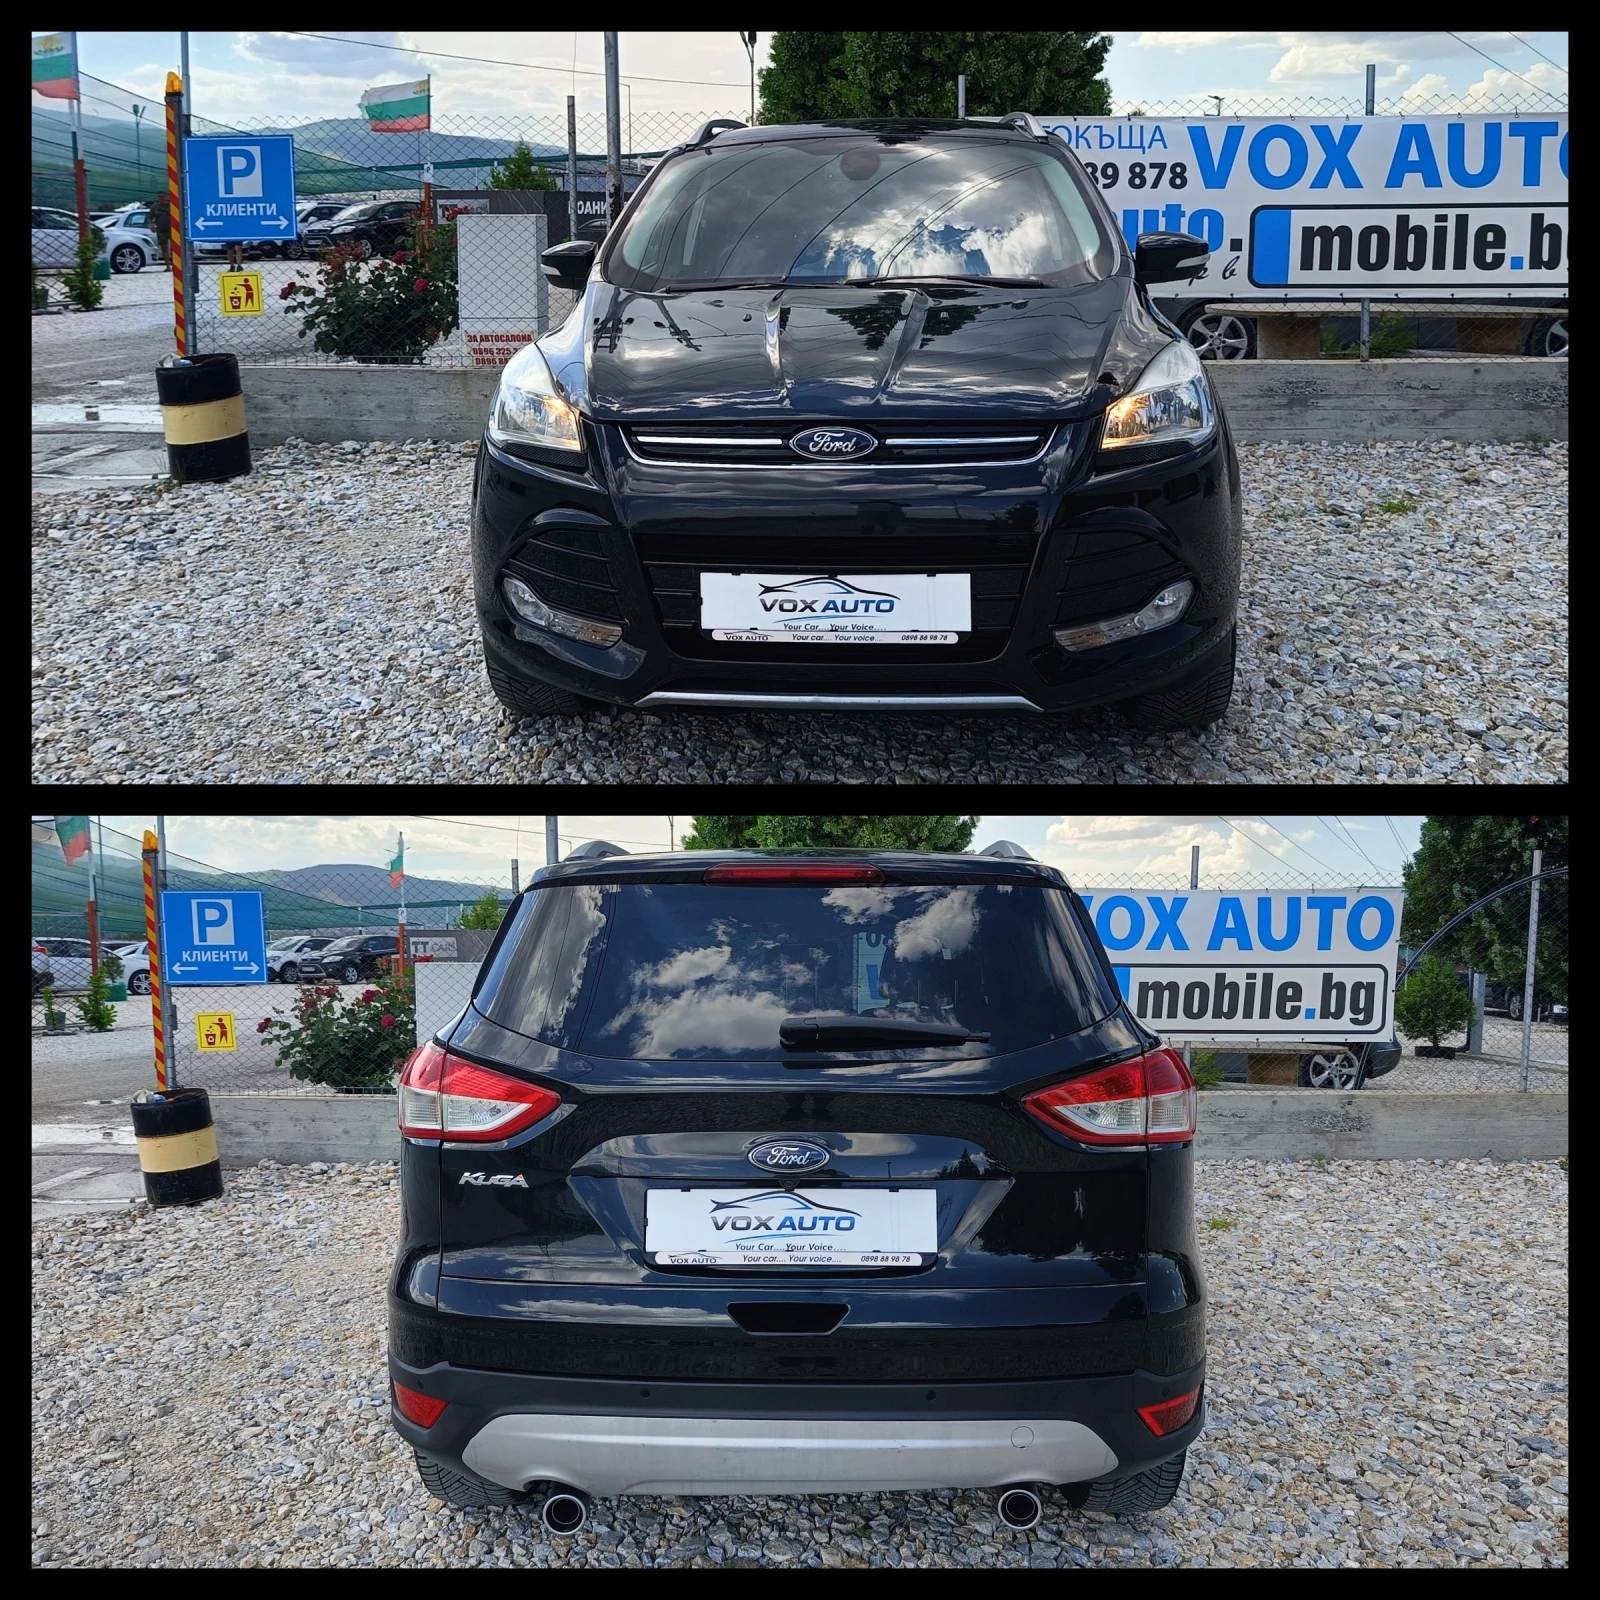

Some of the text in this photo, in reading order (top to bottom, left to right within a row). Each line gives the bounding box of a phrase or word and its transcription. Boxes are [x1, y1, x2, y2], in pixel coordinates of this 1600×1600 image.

[1042, 125, 1168, 154] ОКЪЩА
[1187, 121, 1568, 190] VOX AUT
[1128, 162, 1188, 189] 878
[206, 203, 277, 216] КЛИЕНТИ
[1300, 213, 1568, 271] mobile.b
[480, 334, 532, 342] АВТОСАЛОНА
[809, 431, 856, 452] Ford
[760, 599, 895, 613] VOX AUTO
[792, 633, 809, 641] Your
[1207, 895, 1395, 952] AUTO
[182, 950, 249, 962] КЛИЕНТИ
[1137, 972, 1376, 1026] mobile.bg
[766, 1146, 811, 1165] Ford
[459, 1172, 529, 1188] KUGA
[711, 1216, 856, 1231] VOX AUTO
[735, 1243, 755, 1251] Your
